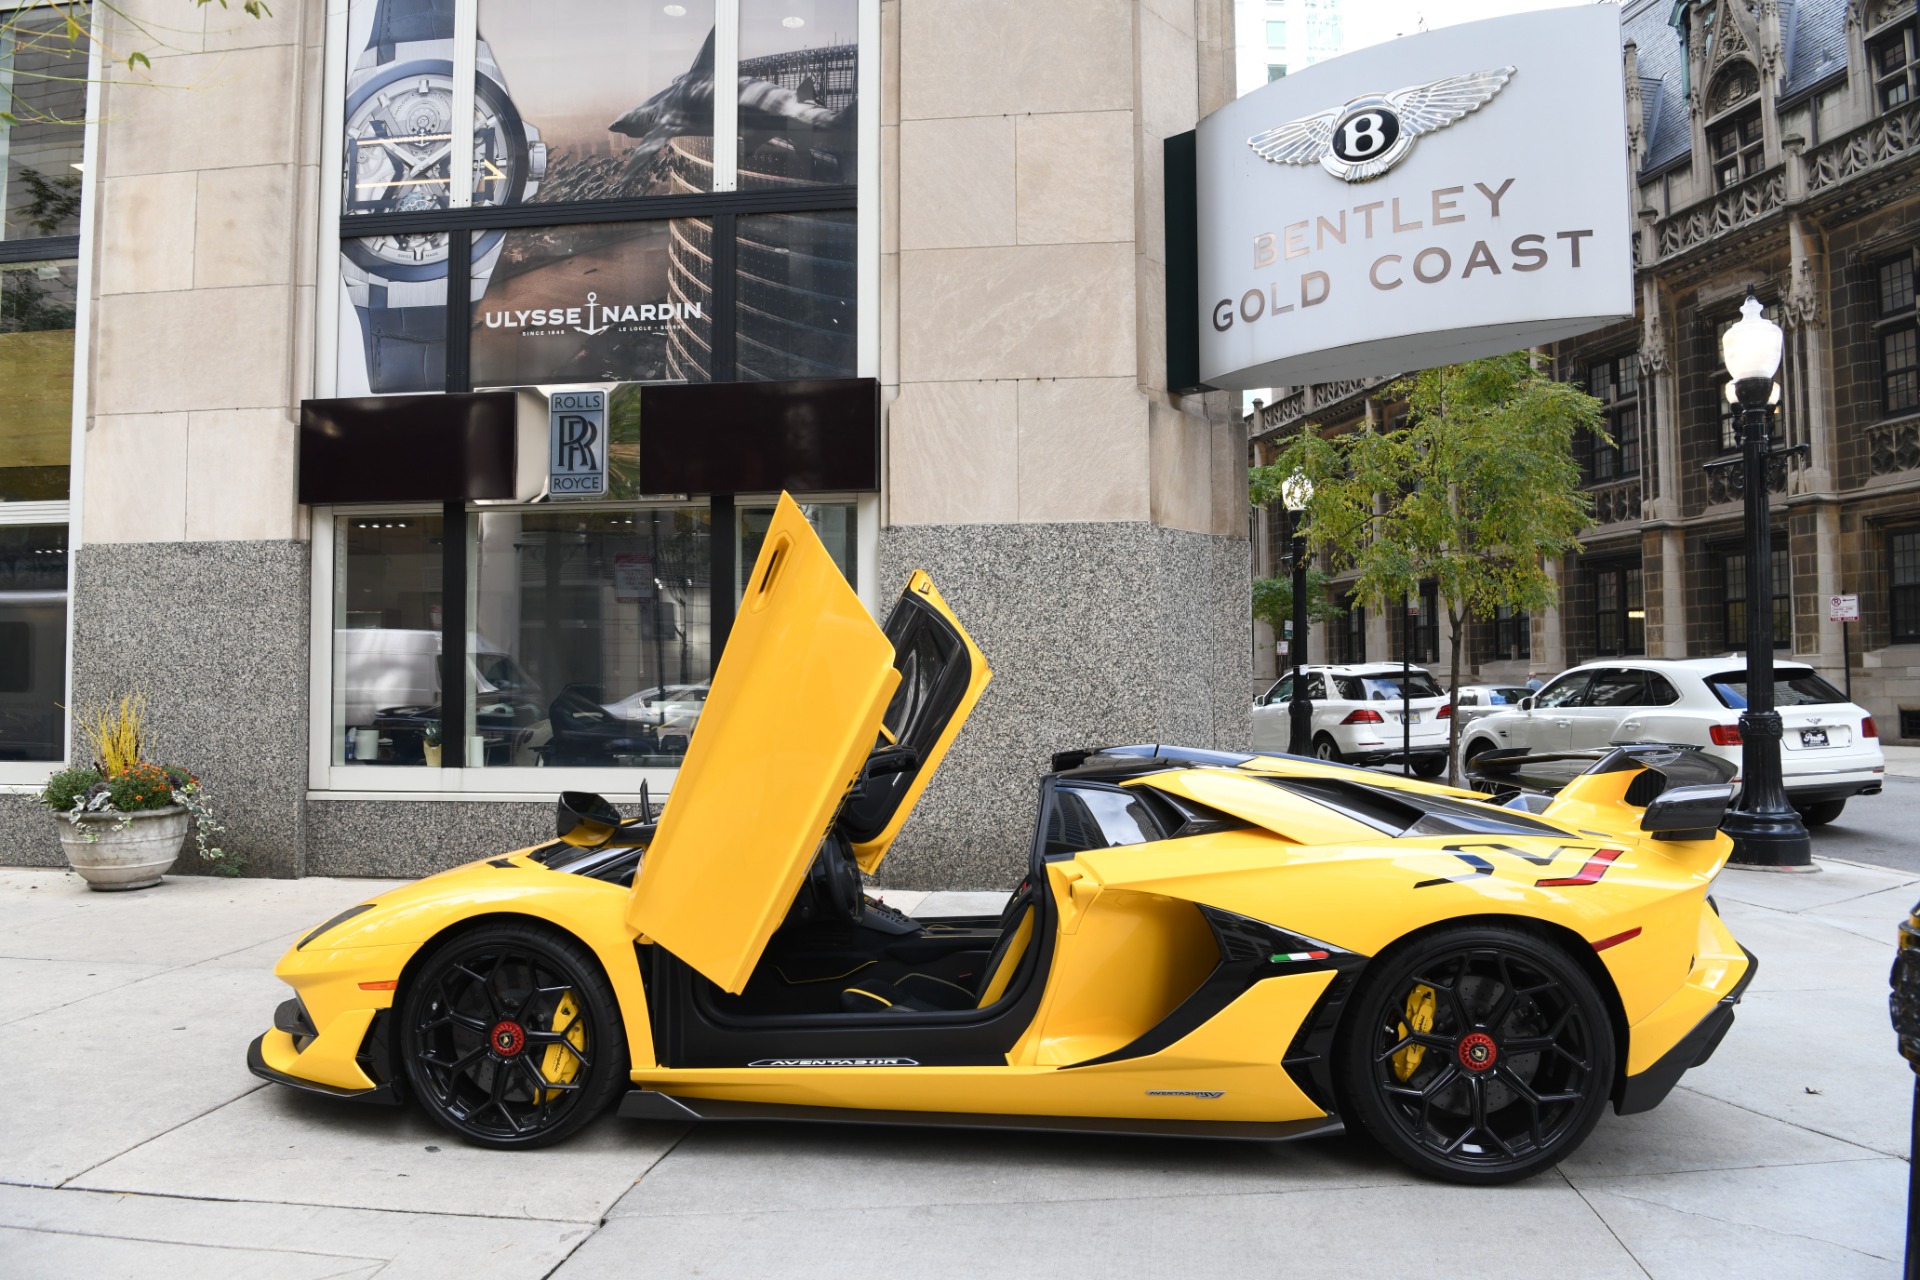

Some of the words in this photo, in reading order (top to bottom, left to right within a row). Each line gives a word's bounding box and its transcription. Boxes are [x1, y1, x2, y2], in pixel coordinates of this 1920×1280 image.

[1343, 112, 1386, 157] B
[1253, 177, 1516, 270] BENTLEY
[1211, 269, 1332, 333] GOLD
[1368, 229, 1594, 291] COAST
[485, 307, 582, 328] ULYSSE
[602, 301, 702, 323] NARDIN
[554, 395, 601, 409] ROLLS
[553, 477, 600, 490] ROYCE
